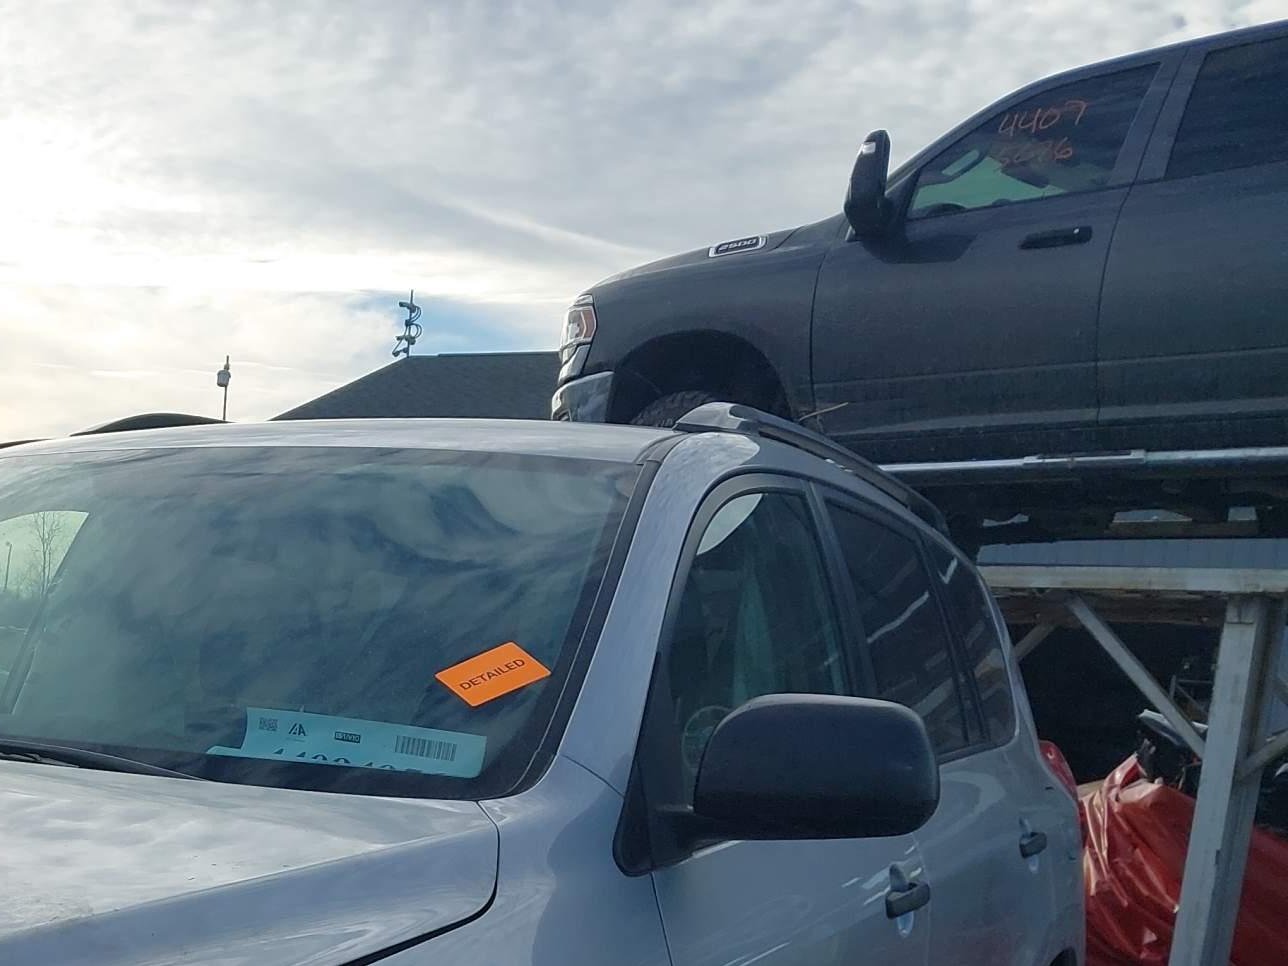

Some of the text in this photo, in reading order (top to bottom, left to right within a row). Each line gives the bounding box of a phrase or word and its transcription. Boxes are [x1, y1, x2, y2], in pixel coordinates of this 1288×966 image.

[998, 99, 1088, 136] 4407
[718, 238, 757, 252] 2500
[459, 659, 526, 690] DETAILED
